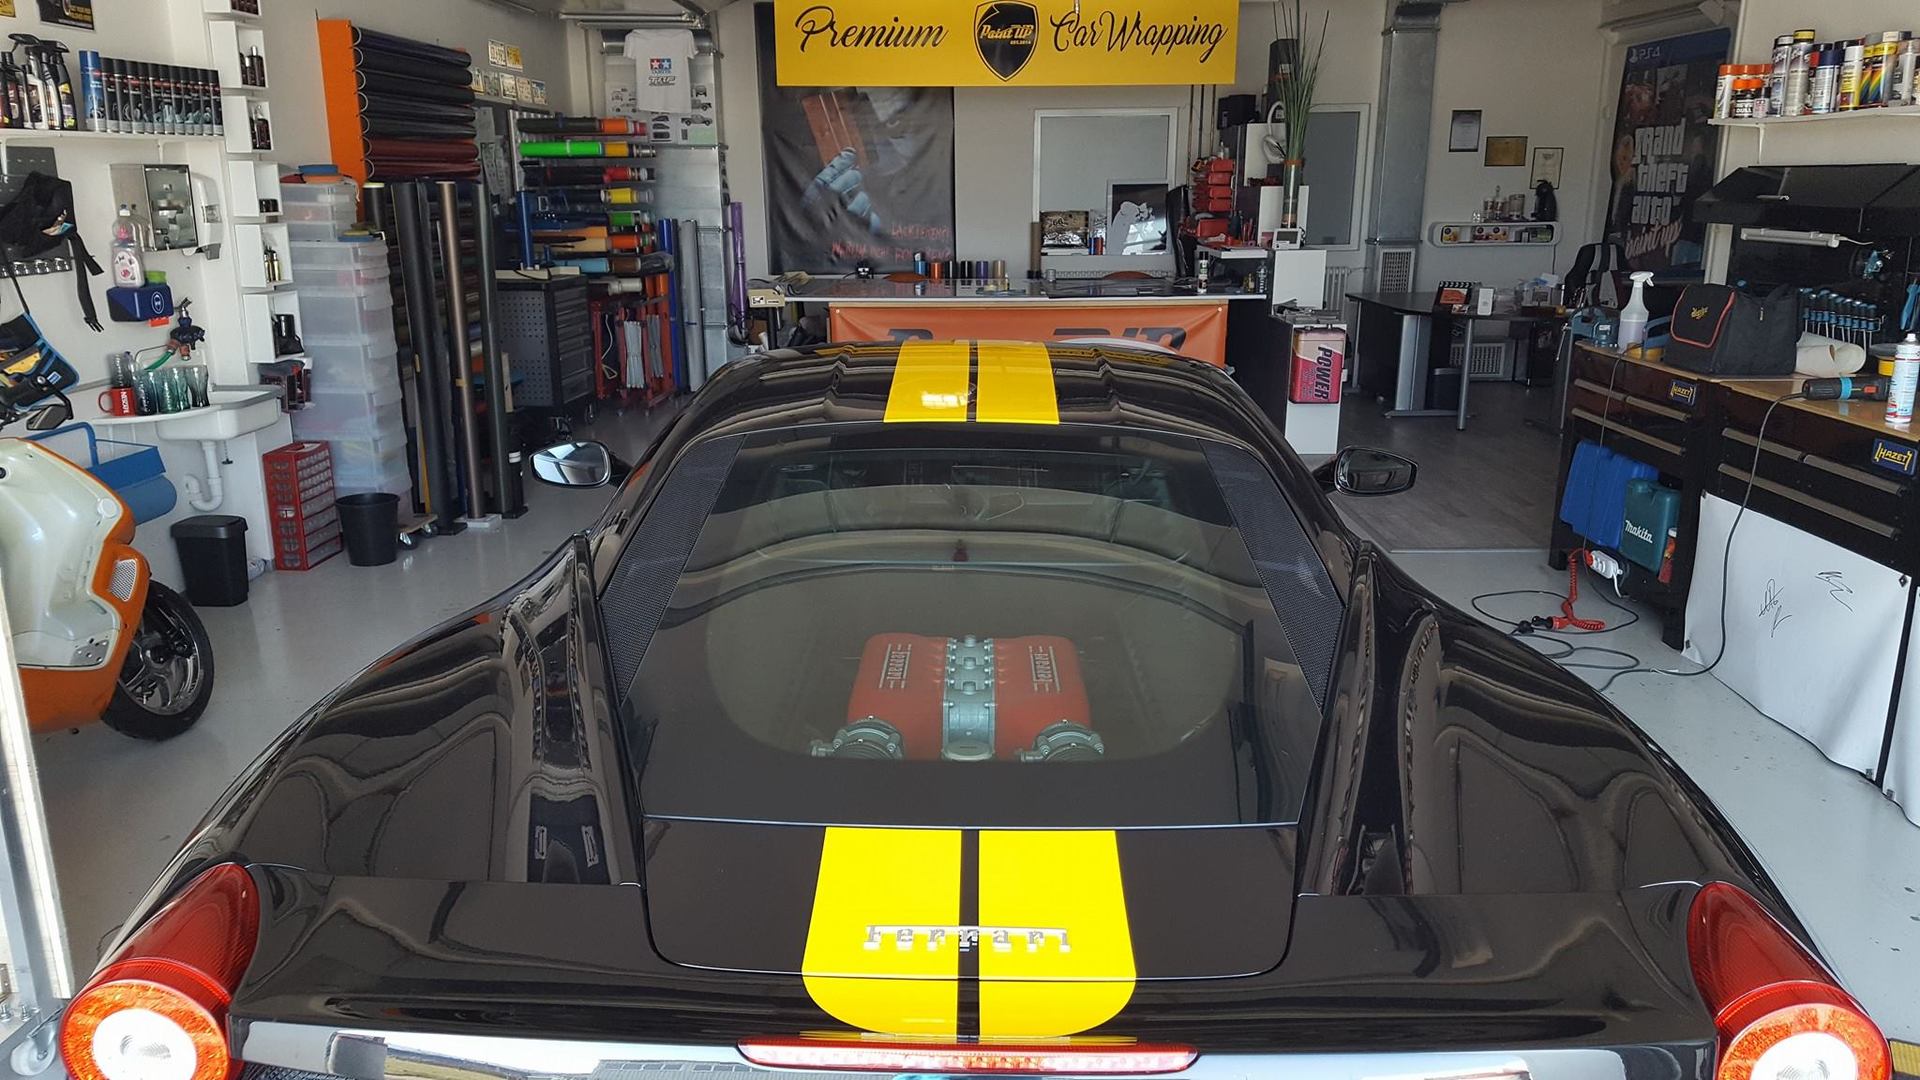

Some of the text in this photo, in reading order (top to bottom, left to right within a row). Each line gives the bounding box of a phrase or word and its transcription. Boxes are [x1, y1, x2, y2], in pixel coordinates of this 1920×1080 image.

[795, 5, 948, 53] Premium
[980, 24, 1013, 39] Paint
[1050, 10, 1228, 63] Car Wrapping
[1639, 46, 1660, 60] PS4
[1315, 345, 1333, 400] POWER
[1878, 446, 1908, 463] HAZET
[1624, 519, 1653, 544] Makita
[864, 925, 1070, 950] Ferrari
